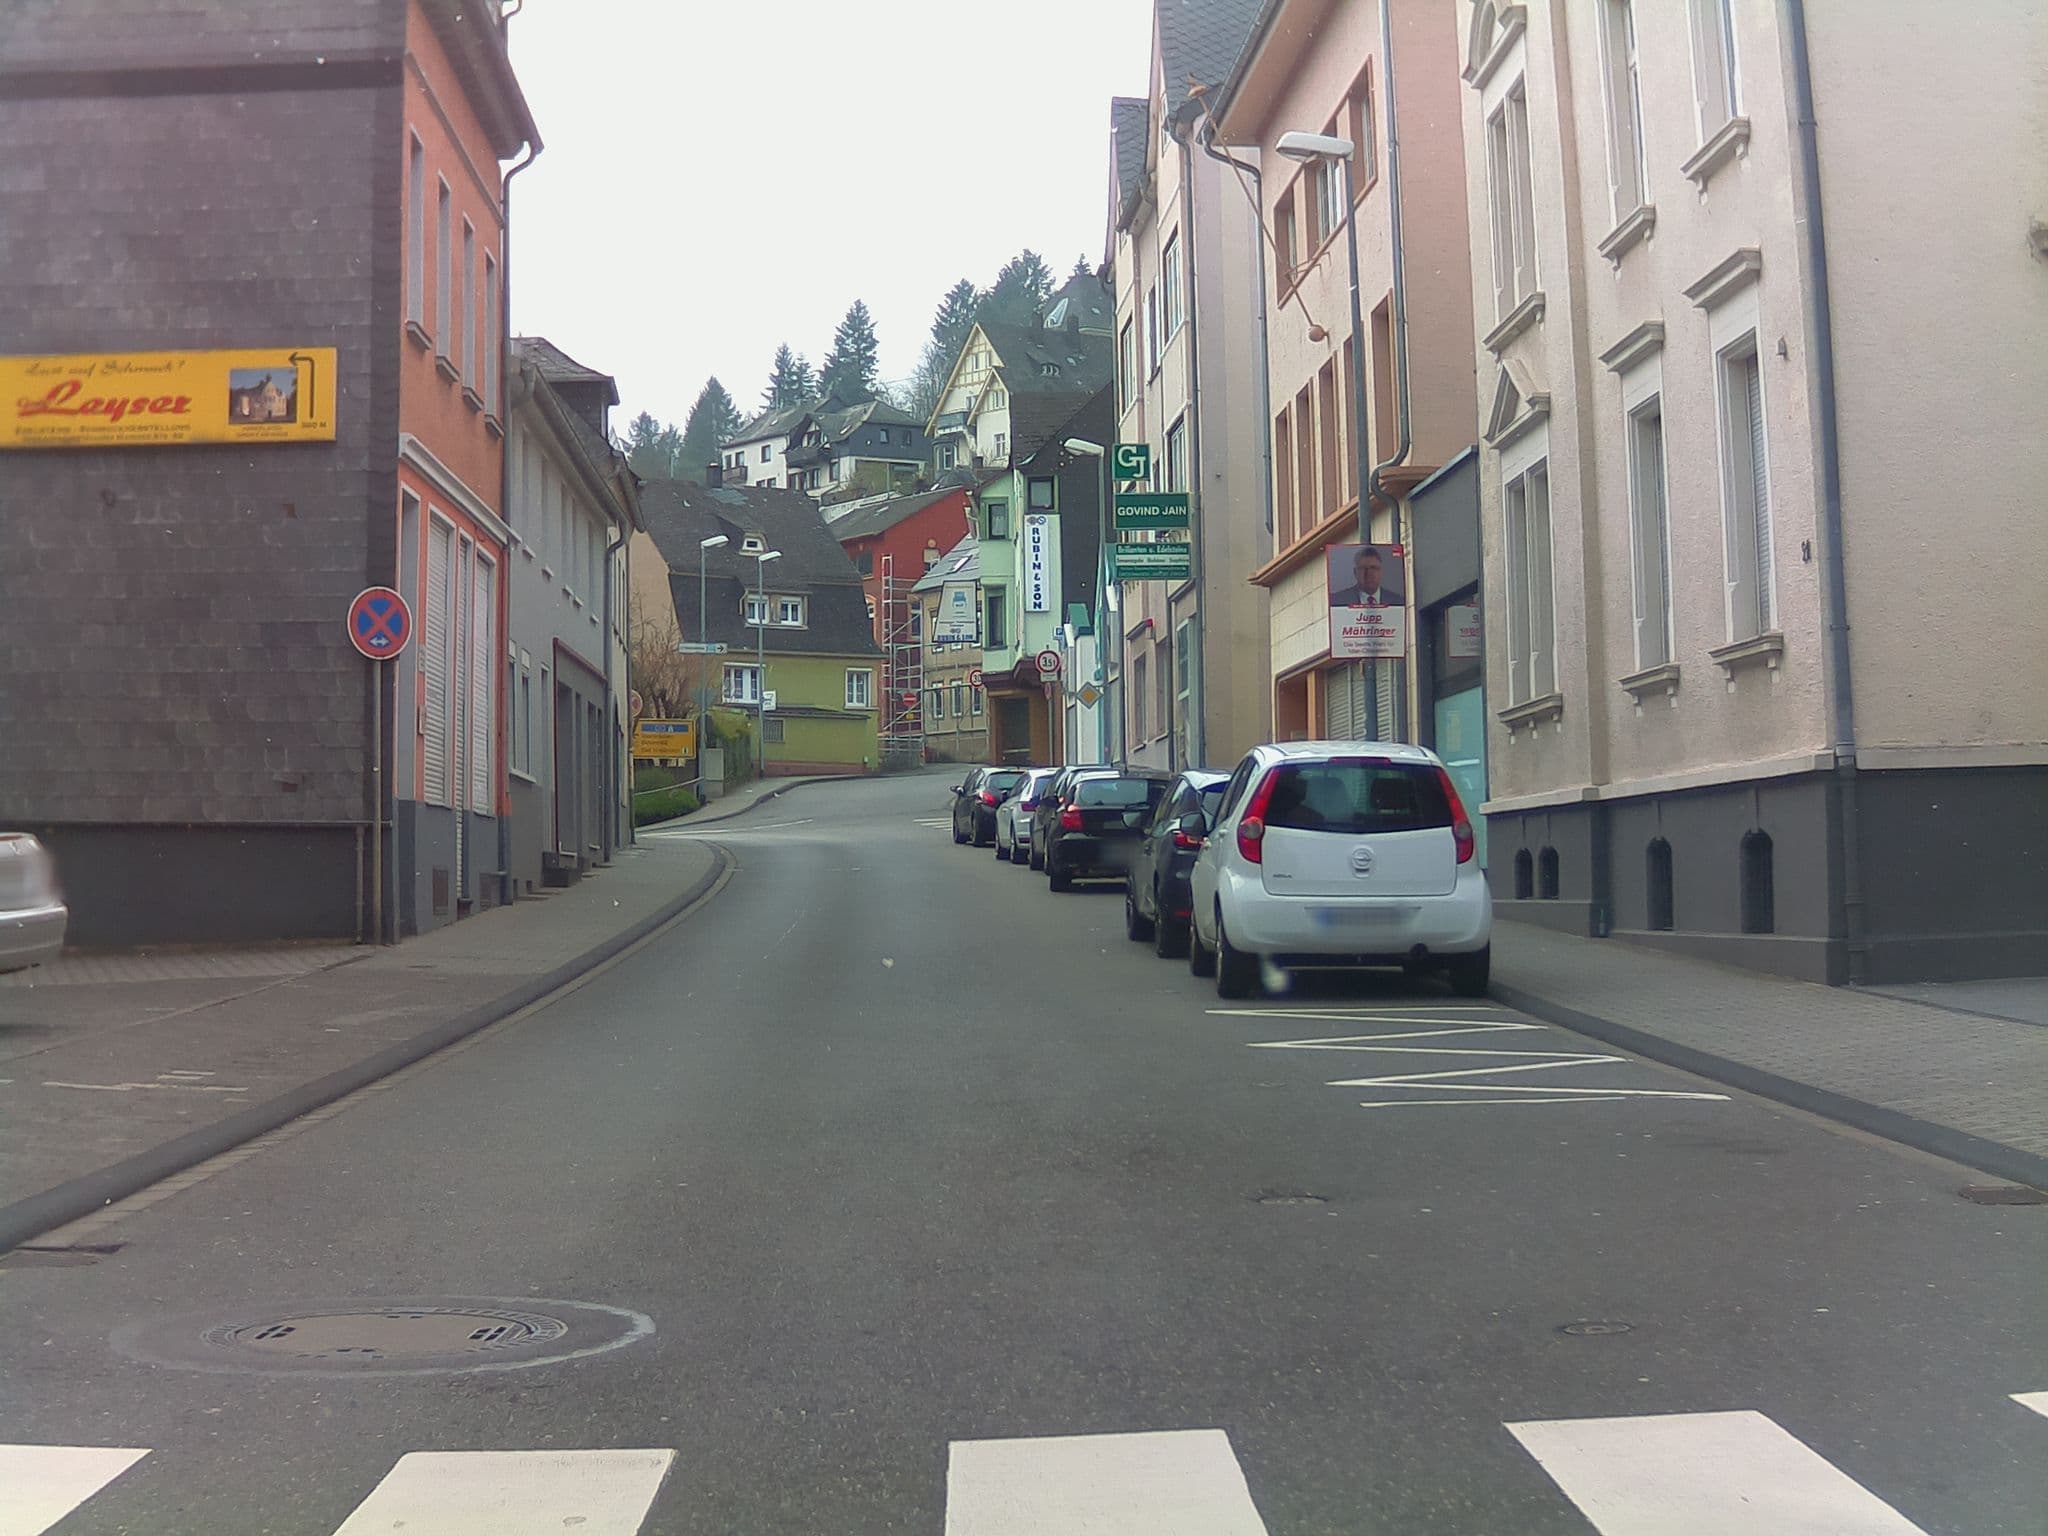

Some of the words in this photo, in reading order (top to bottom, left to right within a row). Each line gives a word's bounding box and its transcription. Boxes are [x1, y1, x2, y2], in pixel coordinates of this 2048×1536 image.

[1117, 506, 1160, 517] GOVIND
[1162, 506, 1187, 516] JAIN
[1032, 527, 1041, 570] RUBIN
[1033, 583, 1042, 609] SON
[1356, 612, 1382, 623] Jupp
[1342, 626, 1396, 637] Mähringer
